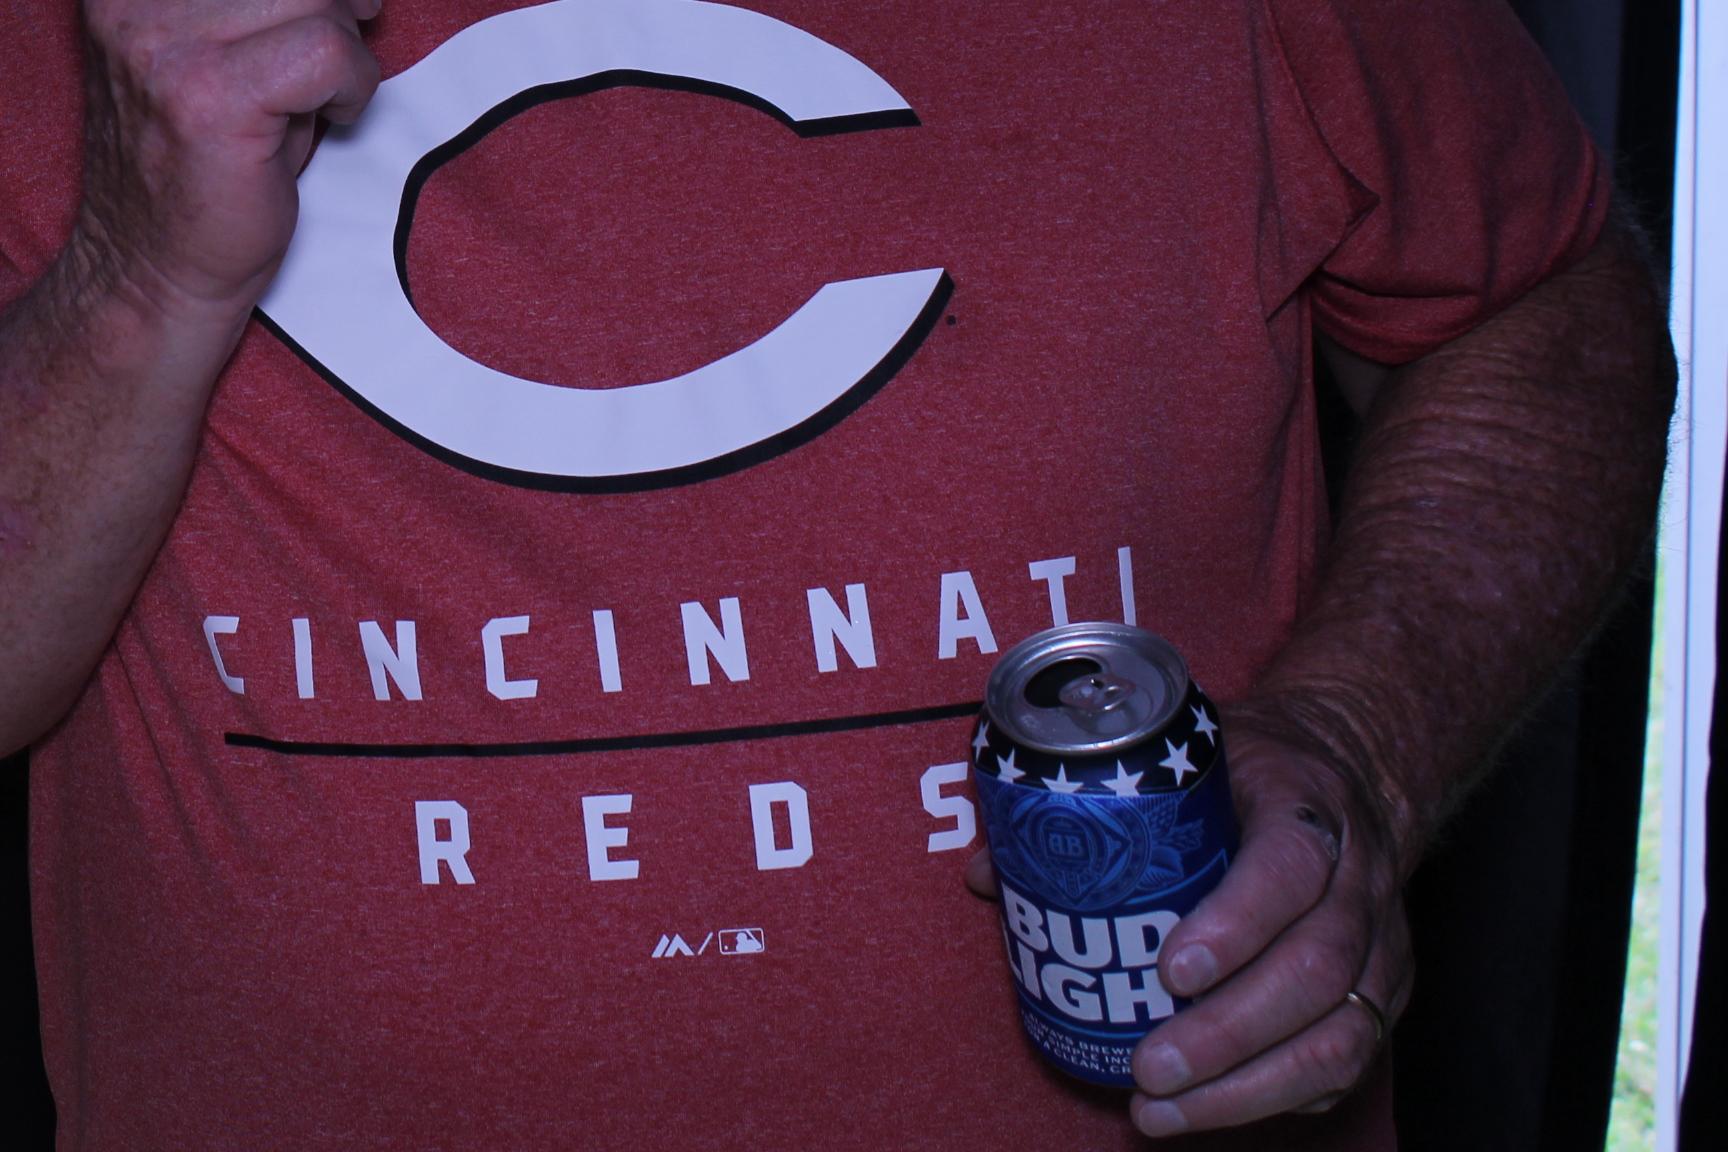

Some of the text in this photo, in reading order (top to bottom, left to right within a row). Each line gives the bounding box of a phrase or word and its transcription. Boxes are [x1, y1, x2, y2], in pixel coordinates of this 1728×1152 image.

[203, 546, 1136, 701] CINCINNATI
[415, 761, 977, 885] REDS
[1001, 879, 1181, 969] BUD
[1029, 1013, 1074, 1045] ALWAYS
[1079, 1041, 1134, 1056] BREWE
[1048, 1035, 1099, 1061] SIMPLE
